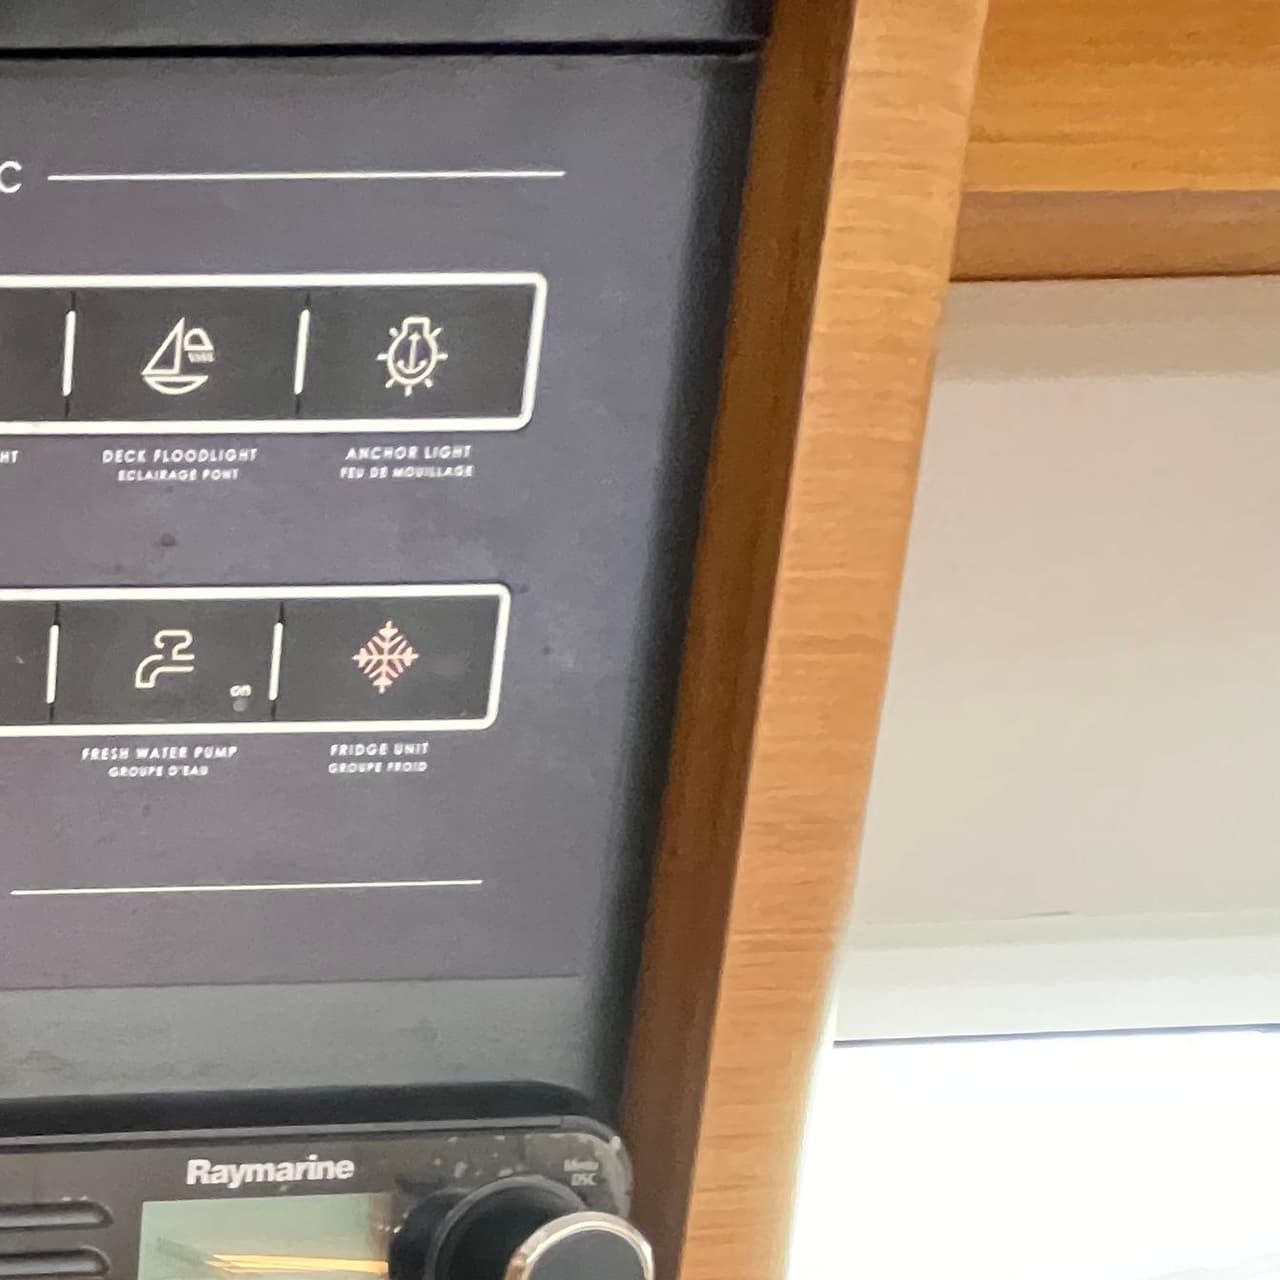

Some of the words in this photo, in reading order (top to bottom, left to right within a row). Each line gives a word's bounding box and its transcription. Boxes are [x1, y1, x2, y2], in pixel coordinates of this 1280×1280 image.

[102, 448, 148, 465] DECK
[153, 447, 259, 464] FLOODLIGHT
[344, 445, 418, 460] ANCHOR
[424, 444, 472, 459] LIGHT
[117, 467, 198, 482] ECLAIRAGE
[202, 467, 240, 481] PONT
[340, 465, 365, 479] FEU
[369, 465, 389, 479] DE
[81, 746, 129, 761] FRESH
[135, 746, 188, 761] WATER
[193, 745, 238, 760] PUMP
[330, 743, 389, 757] FRIDGE
[393, 741, 430, 756] UNIT
[108, 765, 163, 778] GROUPE
[327, 761, 382, 775] GROUPE
[186, 1153, 356, 1189] Raymarine
